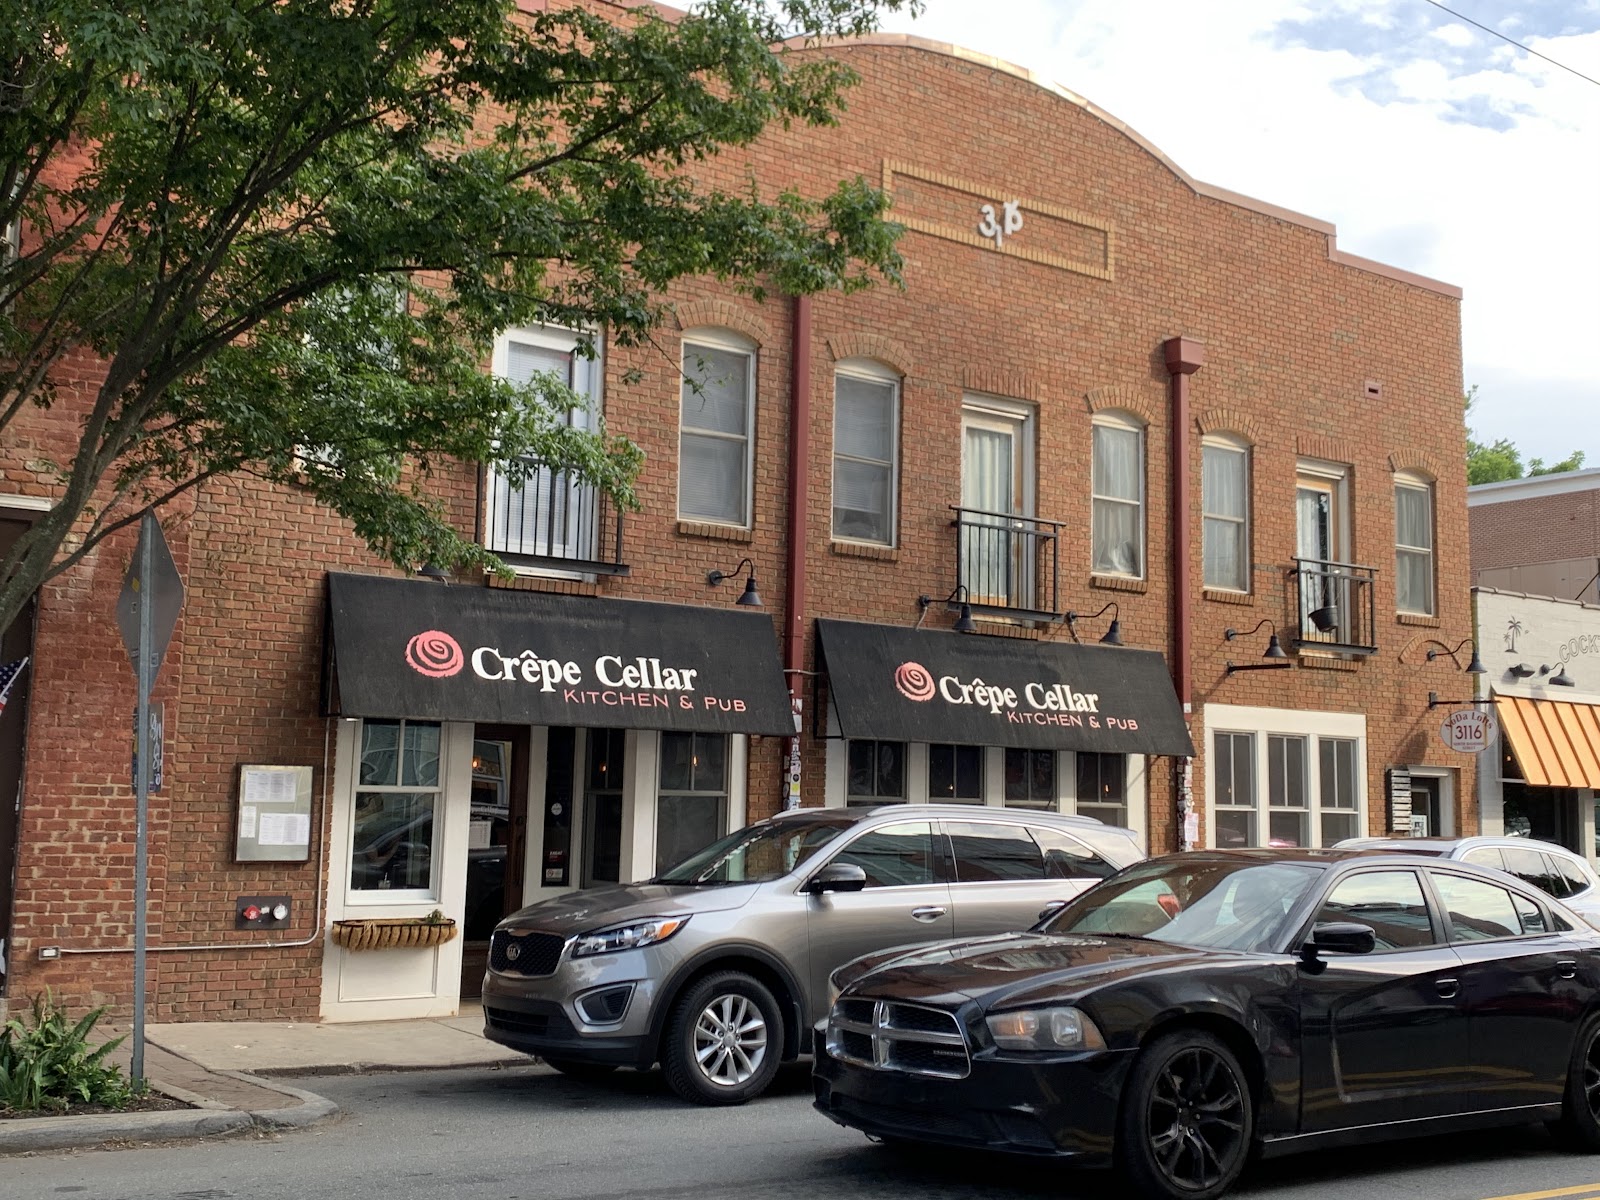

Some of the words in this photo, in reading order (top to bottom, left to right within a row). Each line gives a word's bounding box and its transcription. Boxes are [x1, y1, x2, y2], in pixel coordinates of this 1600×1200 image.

[1559, 634, 1600, 663] COCK
[471, 647, 582, 692] Crêpe
[594, 655, 698, 692] Cellar
[563, 689, 671, 708] KITCHEN
[679, 695, 694, 710] &
[704, 696, 747, 713] PUB
[939, 675, 1018, 714] Crêpe
[1024, 682, 1100, 713] Cellar
[1006, 710, 1083, 727] KITCHEN
[1088, 716, 1101, 729] &
[1106, 716, 1139, 731] PUB
[1455, 725, 1482, 740] 3116
